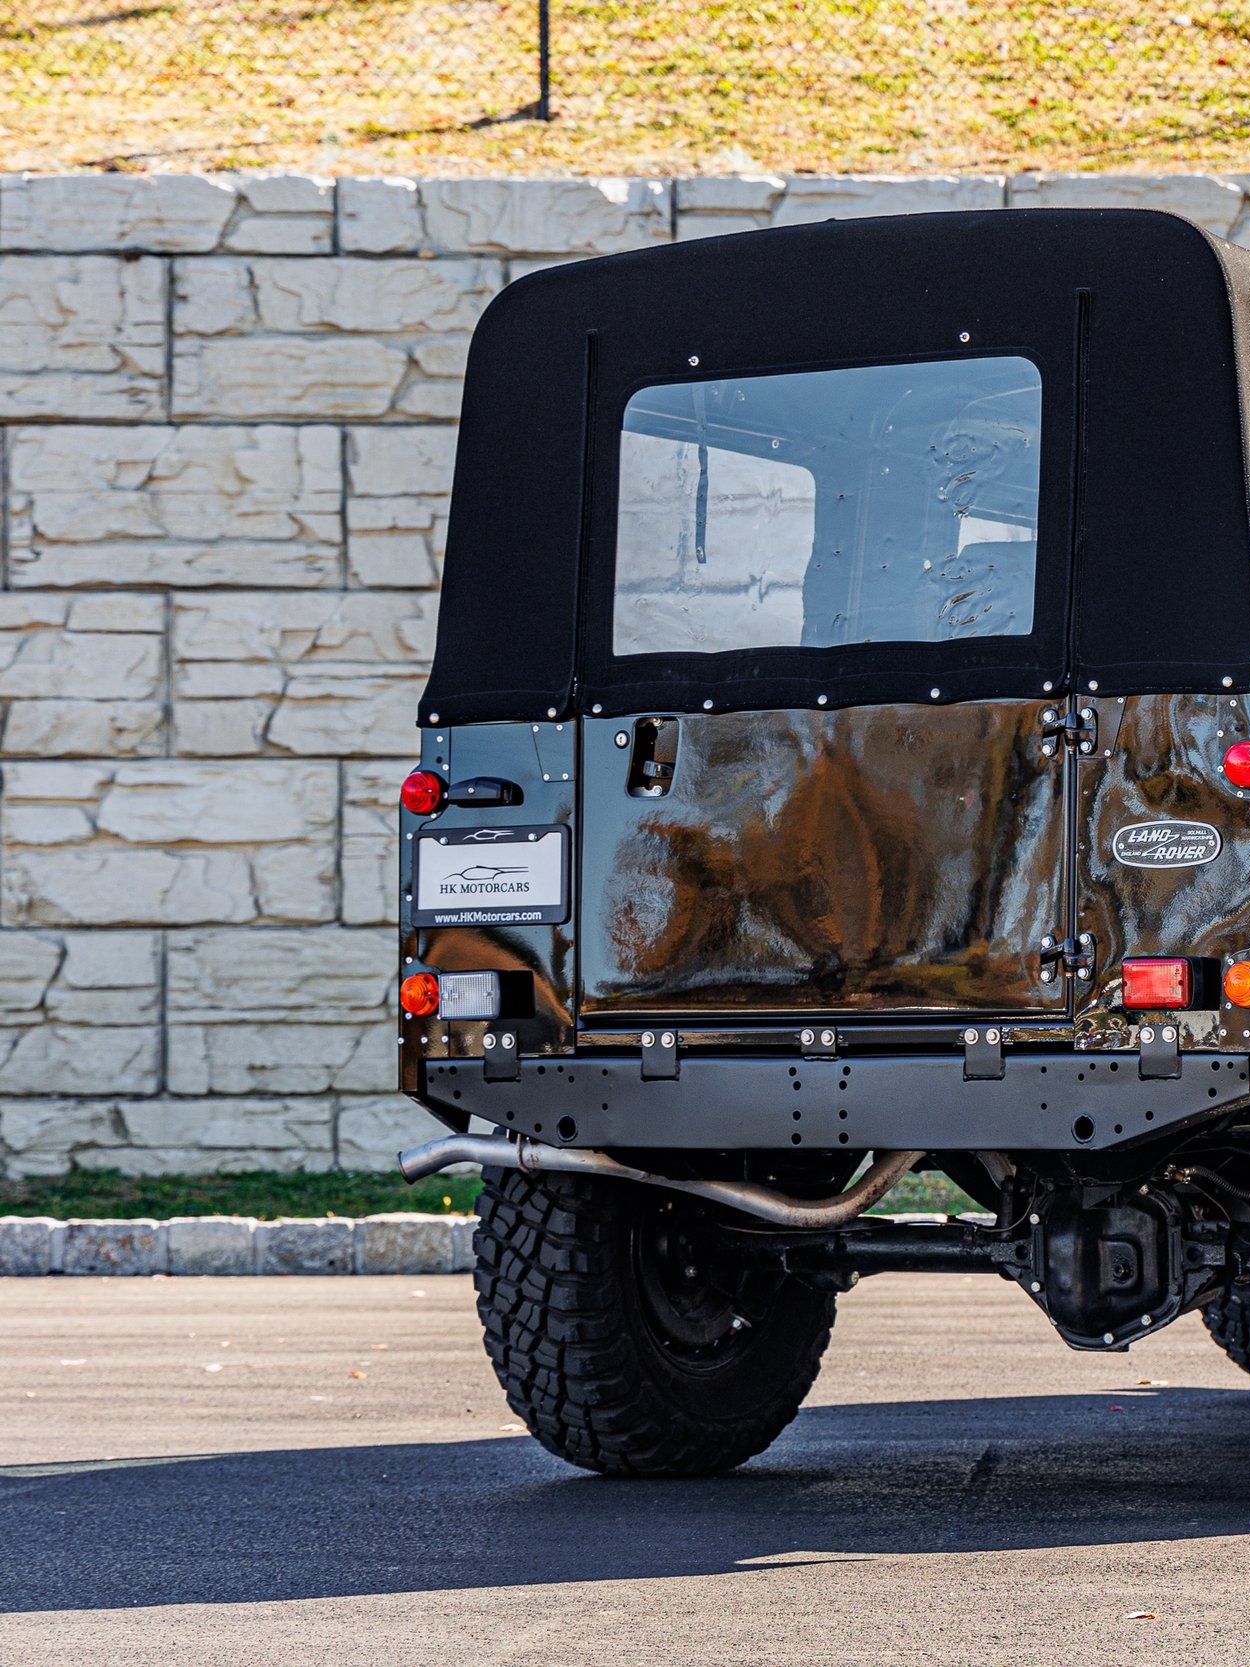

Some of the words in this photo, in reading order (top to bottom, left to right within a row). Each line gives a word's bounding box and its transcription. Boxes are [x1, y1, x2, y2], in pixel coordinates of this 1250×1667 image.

[1127, 829, 1171, 843] LAND
[1153, 846, 1206, 860] ROVER
[440, 884, 457, 894] HK
[460, 882, 530, 894] MOTORCARS
[434, 911, 542, 924] www.HKMotorcars.com
